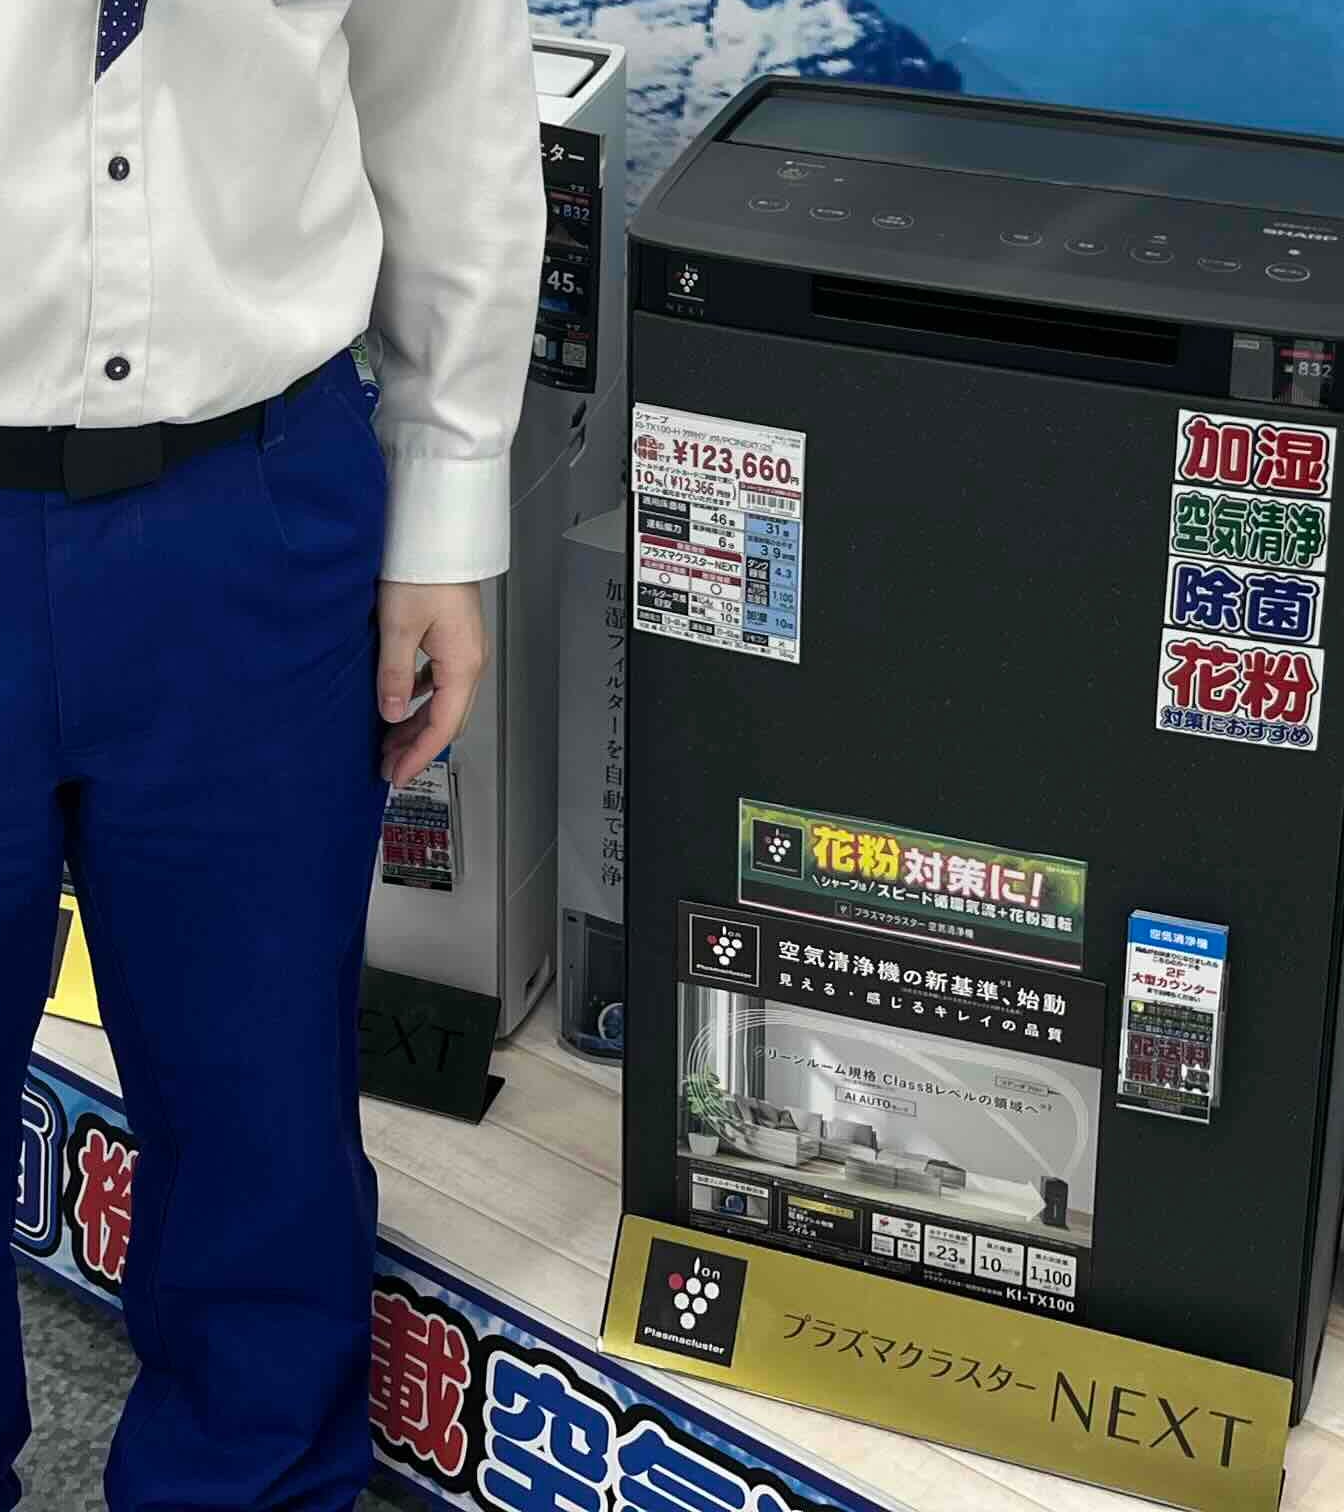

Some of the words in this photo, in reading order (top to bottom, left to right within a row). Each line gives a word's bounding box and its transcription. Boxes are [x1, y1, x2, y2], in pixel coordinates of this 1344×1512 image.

[1183, 416, 1327, 494] 加湿
[1175, 492, 1324, 567] 空気清浄
[1173, 565, 1320, 641] 除菌
[1165, 638, 1317, 726] 花粉
[1159, 706, 1313, 747] 対策におすすめ
[777, 971, 1064, 1044] 見える・感じるキレイの品質
[1005, 1287, 1076, 1314] KI-TX100
[643, 1325, 726, 1356] Plasmacluster
[781, 1311, 1037, 1396] プラズマクラスター
[1051, 1368, 1254, 1469] NEXT
